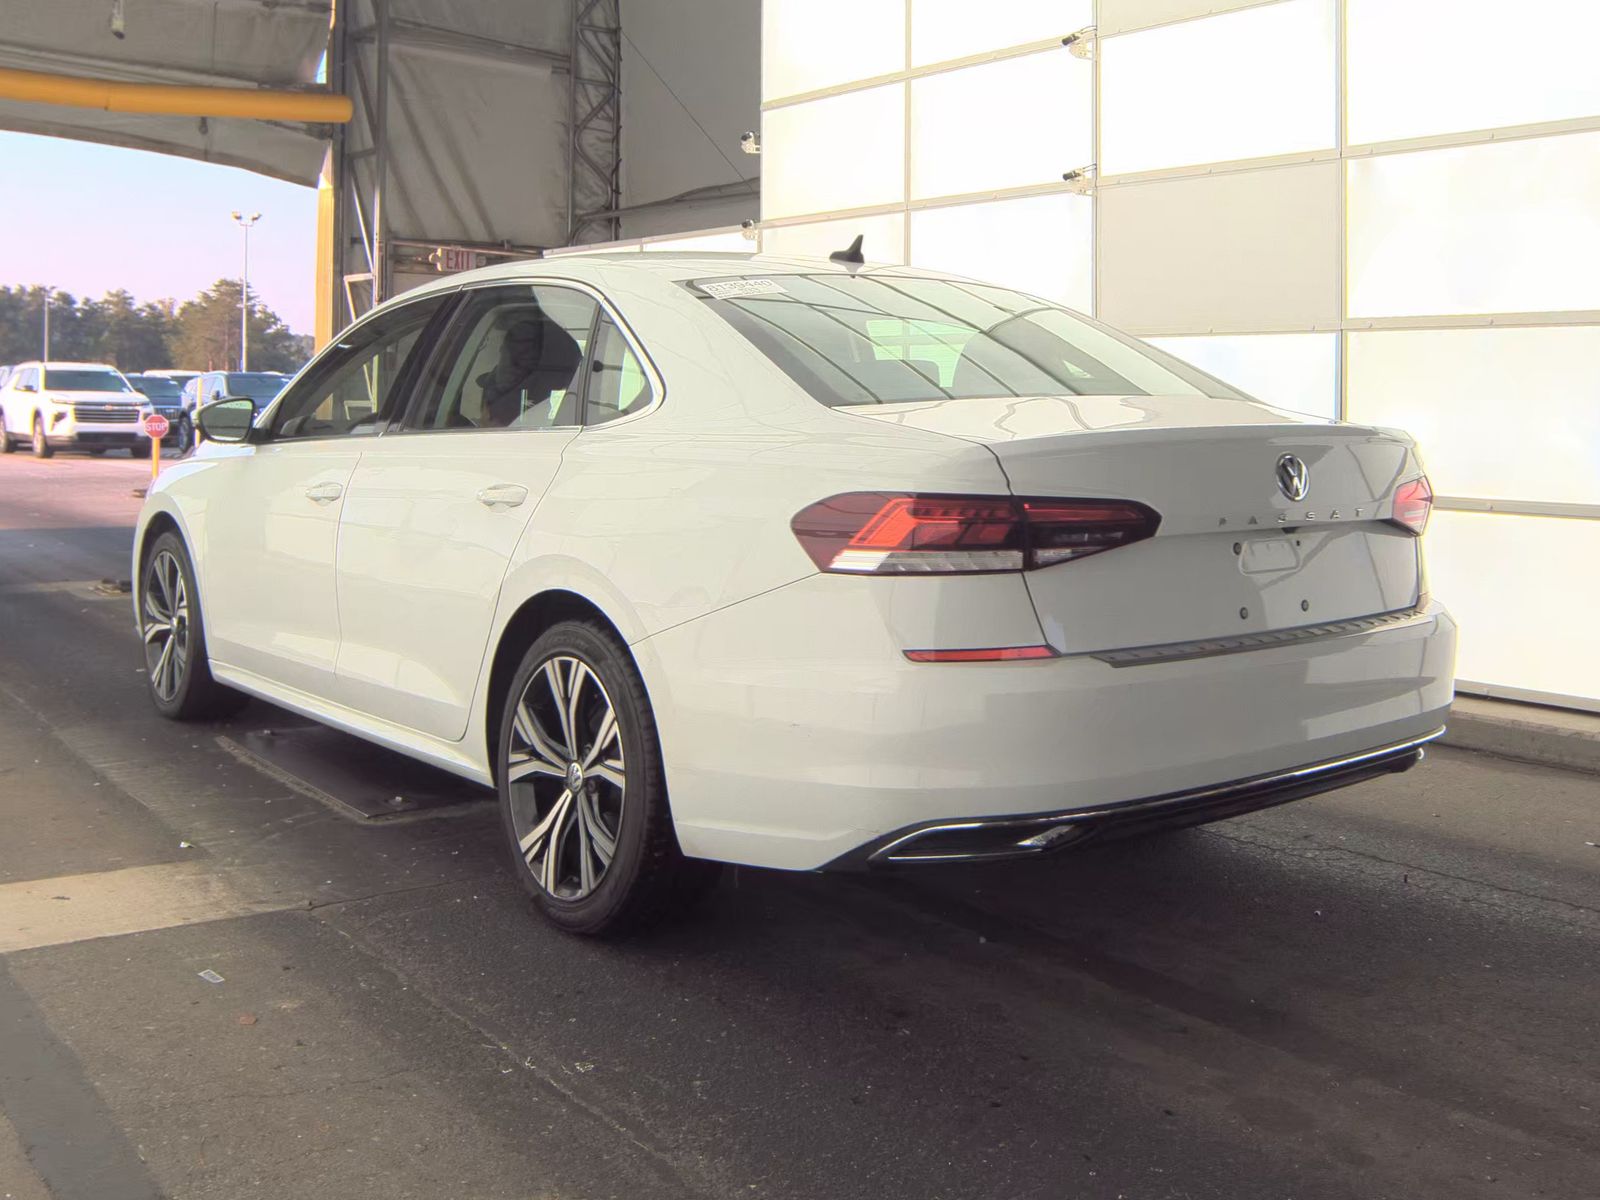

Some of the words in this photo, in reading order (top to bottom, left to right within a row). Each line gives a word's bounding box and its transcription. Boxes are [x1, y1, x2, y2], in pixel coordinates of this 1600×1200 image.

[446, 249, 473, 270] EXIT
[146, 422, 167, 432] STOP
[1218, 507, 1366, 527] PASSAT
